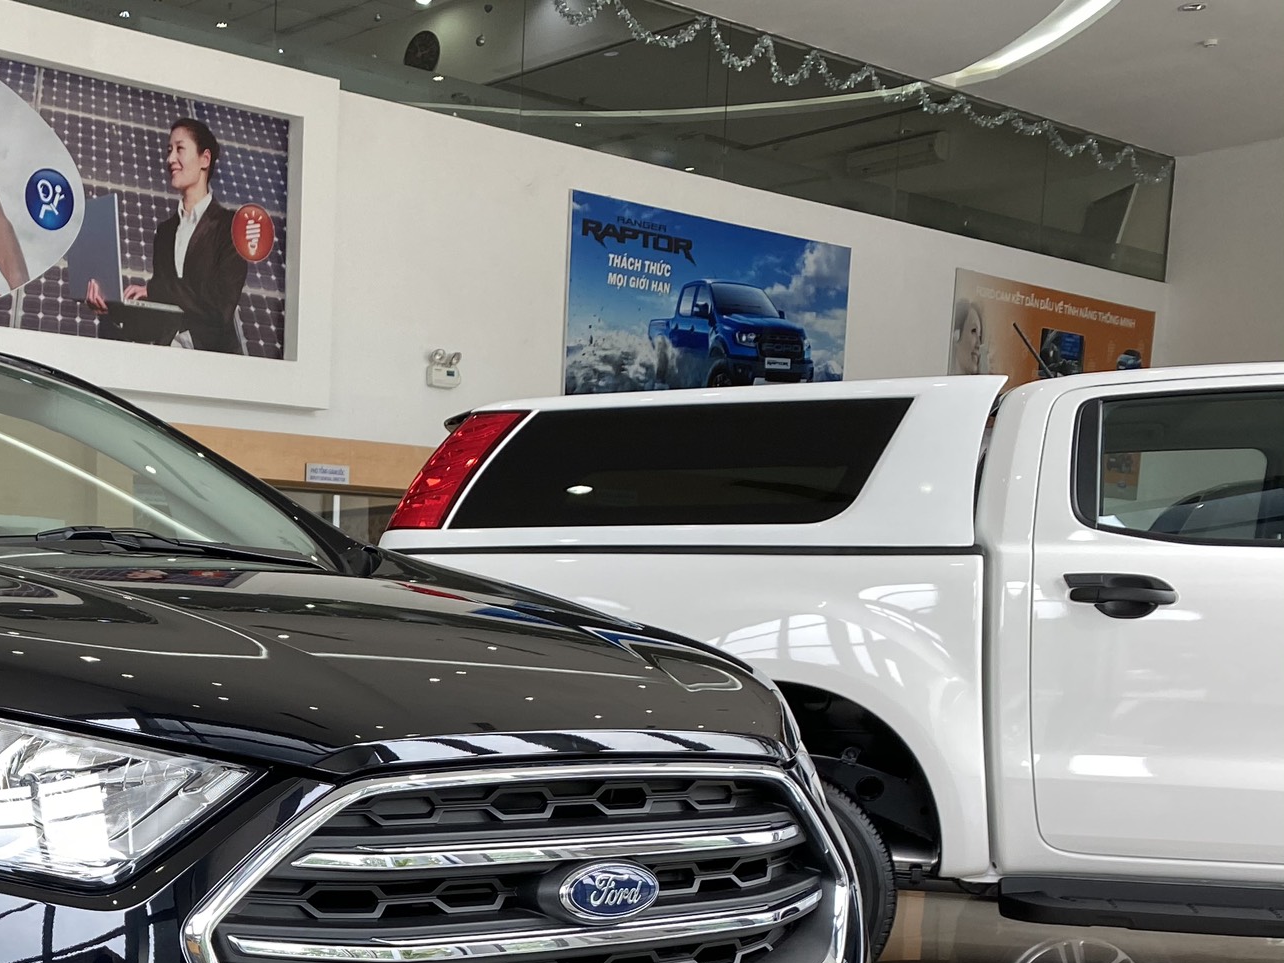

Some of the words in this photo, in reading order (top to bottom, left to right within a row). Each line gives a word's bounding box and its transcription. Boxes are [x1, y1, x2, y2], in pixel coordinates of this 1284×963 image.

[617, 215, 667, 233] RANGER
[582, 218, 697, 267] RAPTOR
[608, 252, 642, 272] THÁCH
[644, 259, 672, 277] THỨC
[607, 272, 628, 290] MỌI
[629, 275, 650, 291] GIỚI
[651, 281, 671, 297] HẠN
[588, 873, 642, 907] Ford
